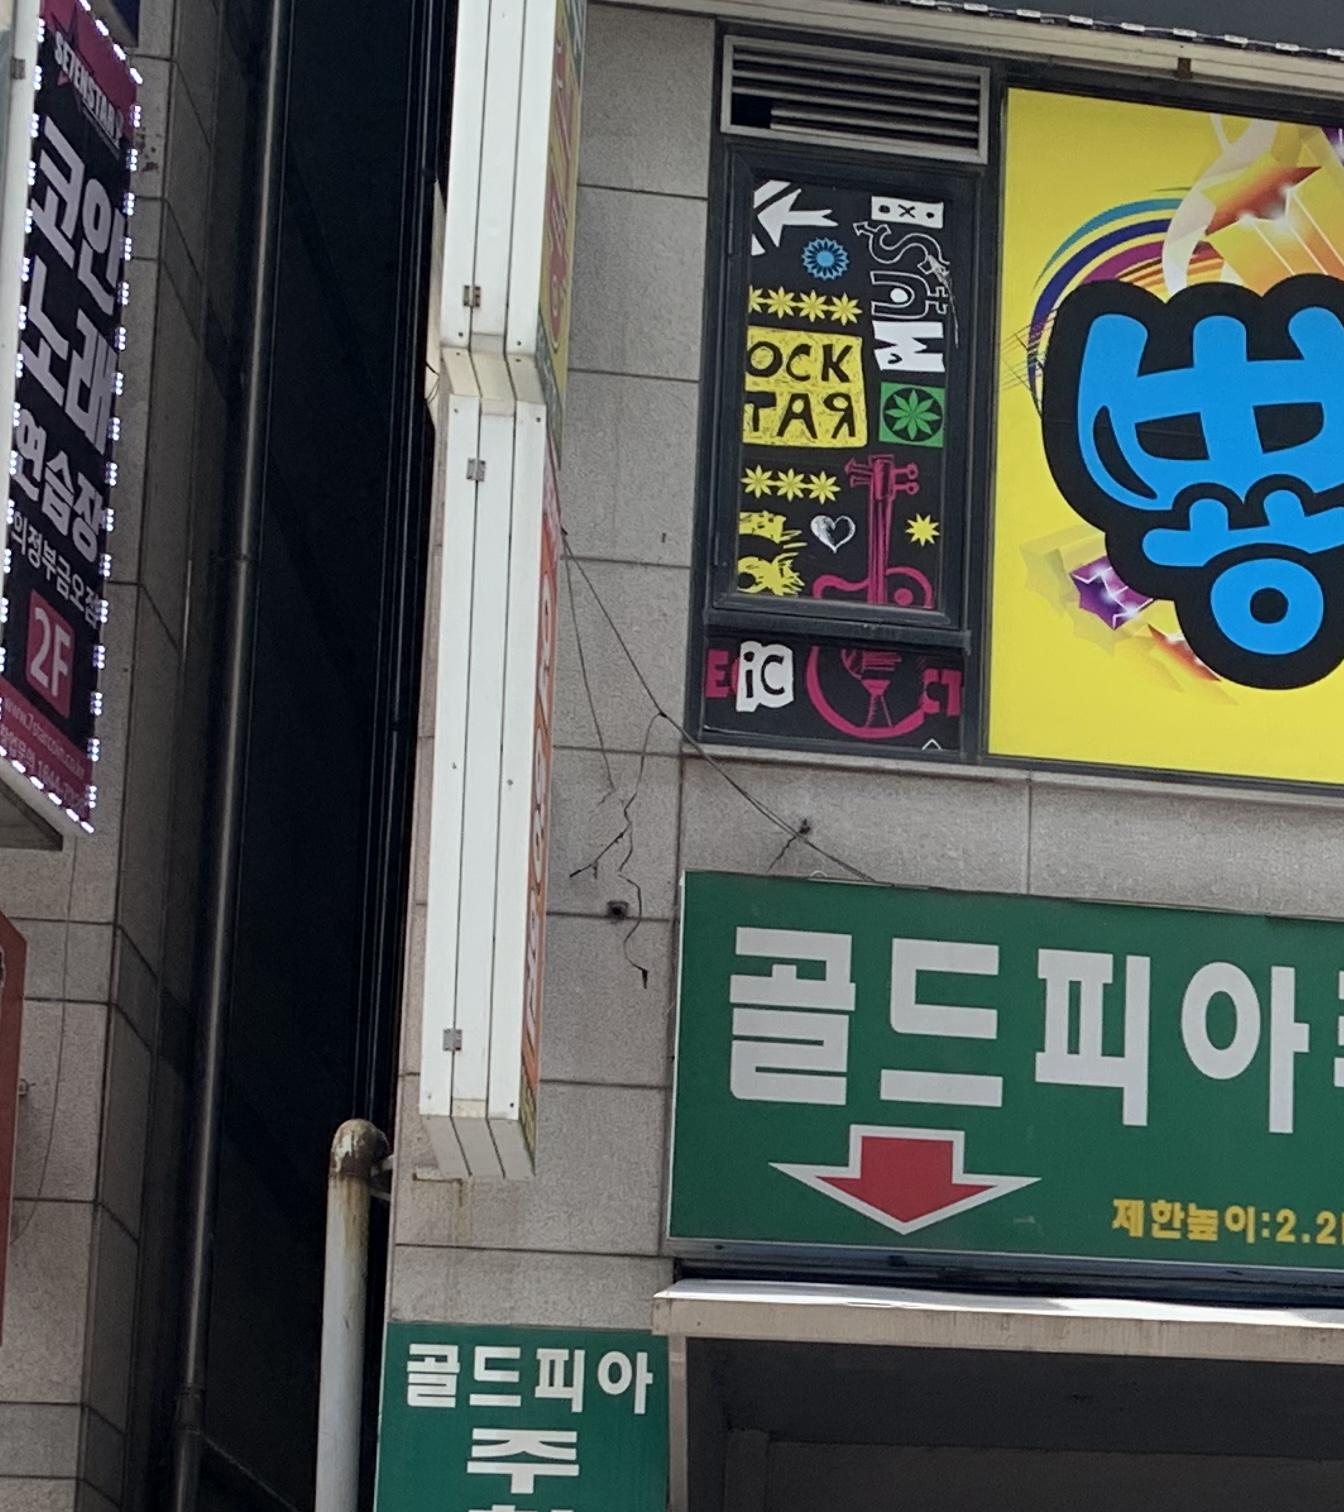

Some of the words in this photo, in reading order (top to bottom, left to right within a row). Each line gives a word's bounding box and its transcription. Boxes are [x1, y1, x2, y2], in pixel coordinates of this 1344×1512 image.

[20, 255, 118, 455] 노래
[11, 409, 103, 563] 연습장
[30, 607, 73, 698] 2F
[406, 1341, 654, 1415] 골드피아
